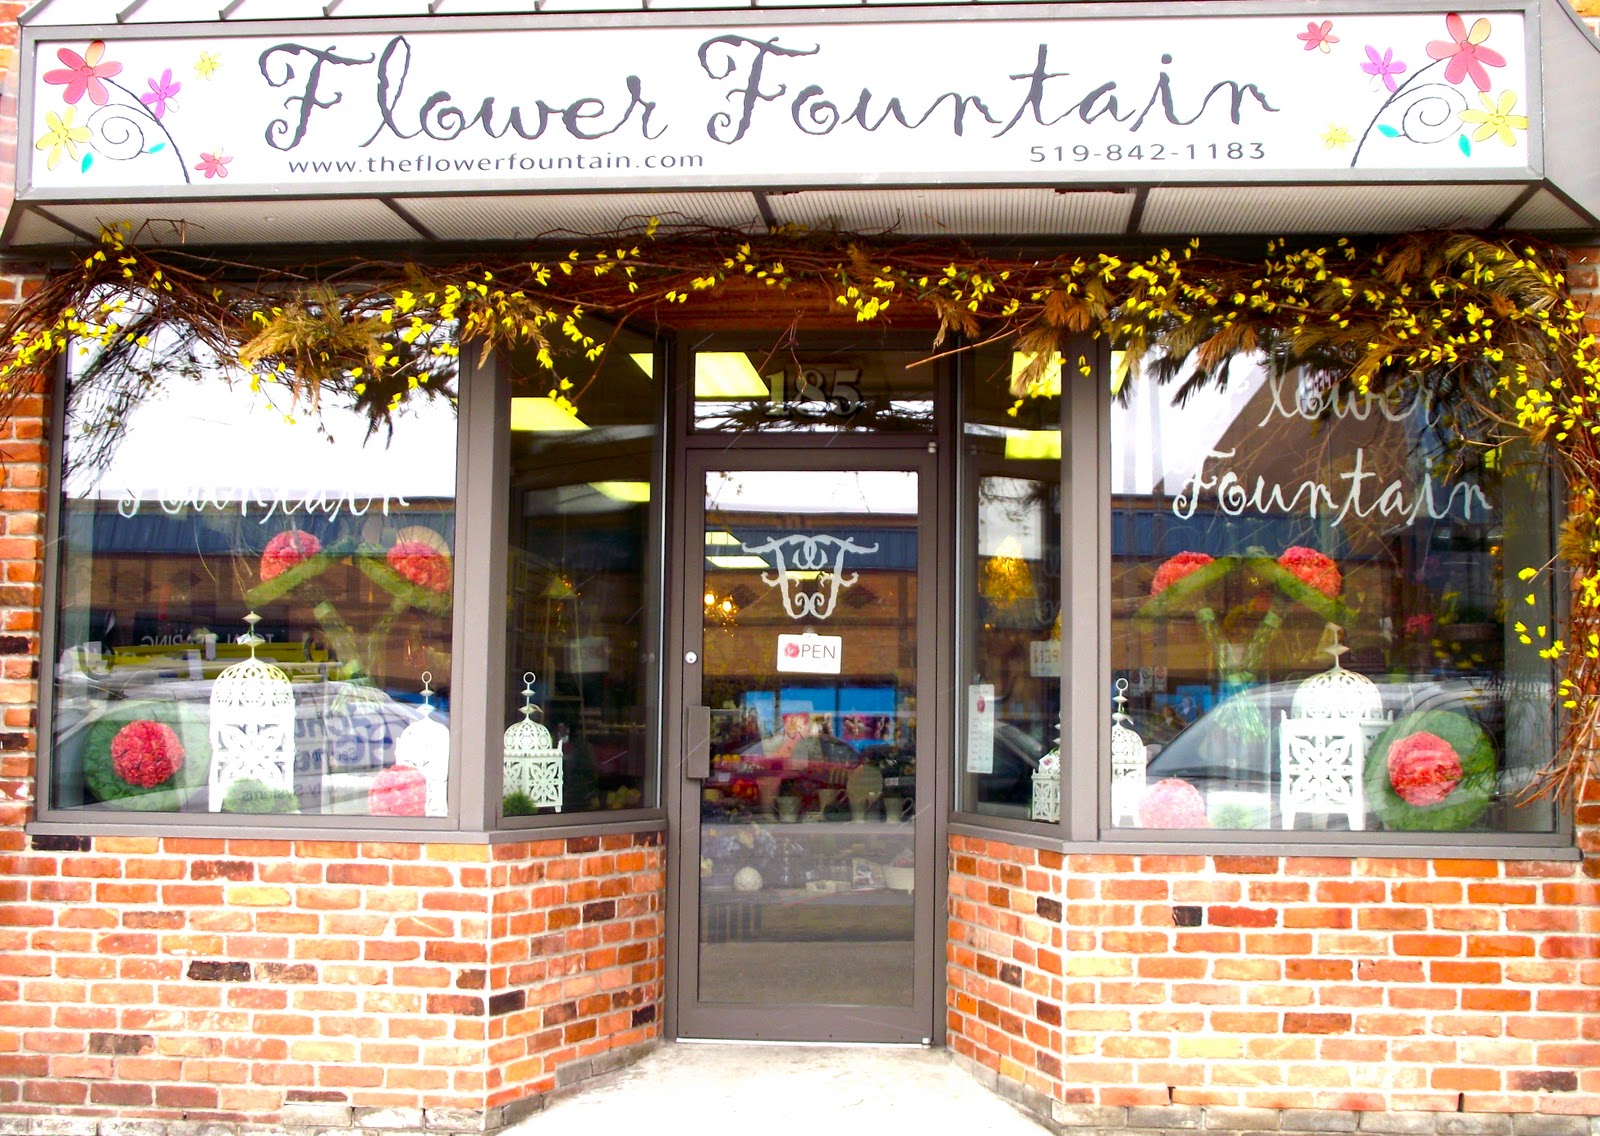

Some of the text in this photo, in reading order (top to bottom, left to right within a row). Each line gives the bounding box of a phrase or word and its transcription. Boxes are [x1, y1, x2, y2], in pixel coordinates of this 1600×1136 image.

[259, 34, 1280, 151] Flower Fountain
[288, 151, 704, 174] www.theflowerfountain.com
[1028, 142, 1266, 164] 519-842-1183
[765, 368, 862, 417] 185
